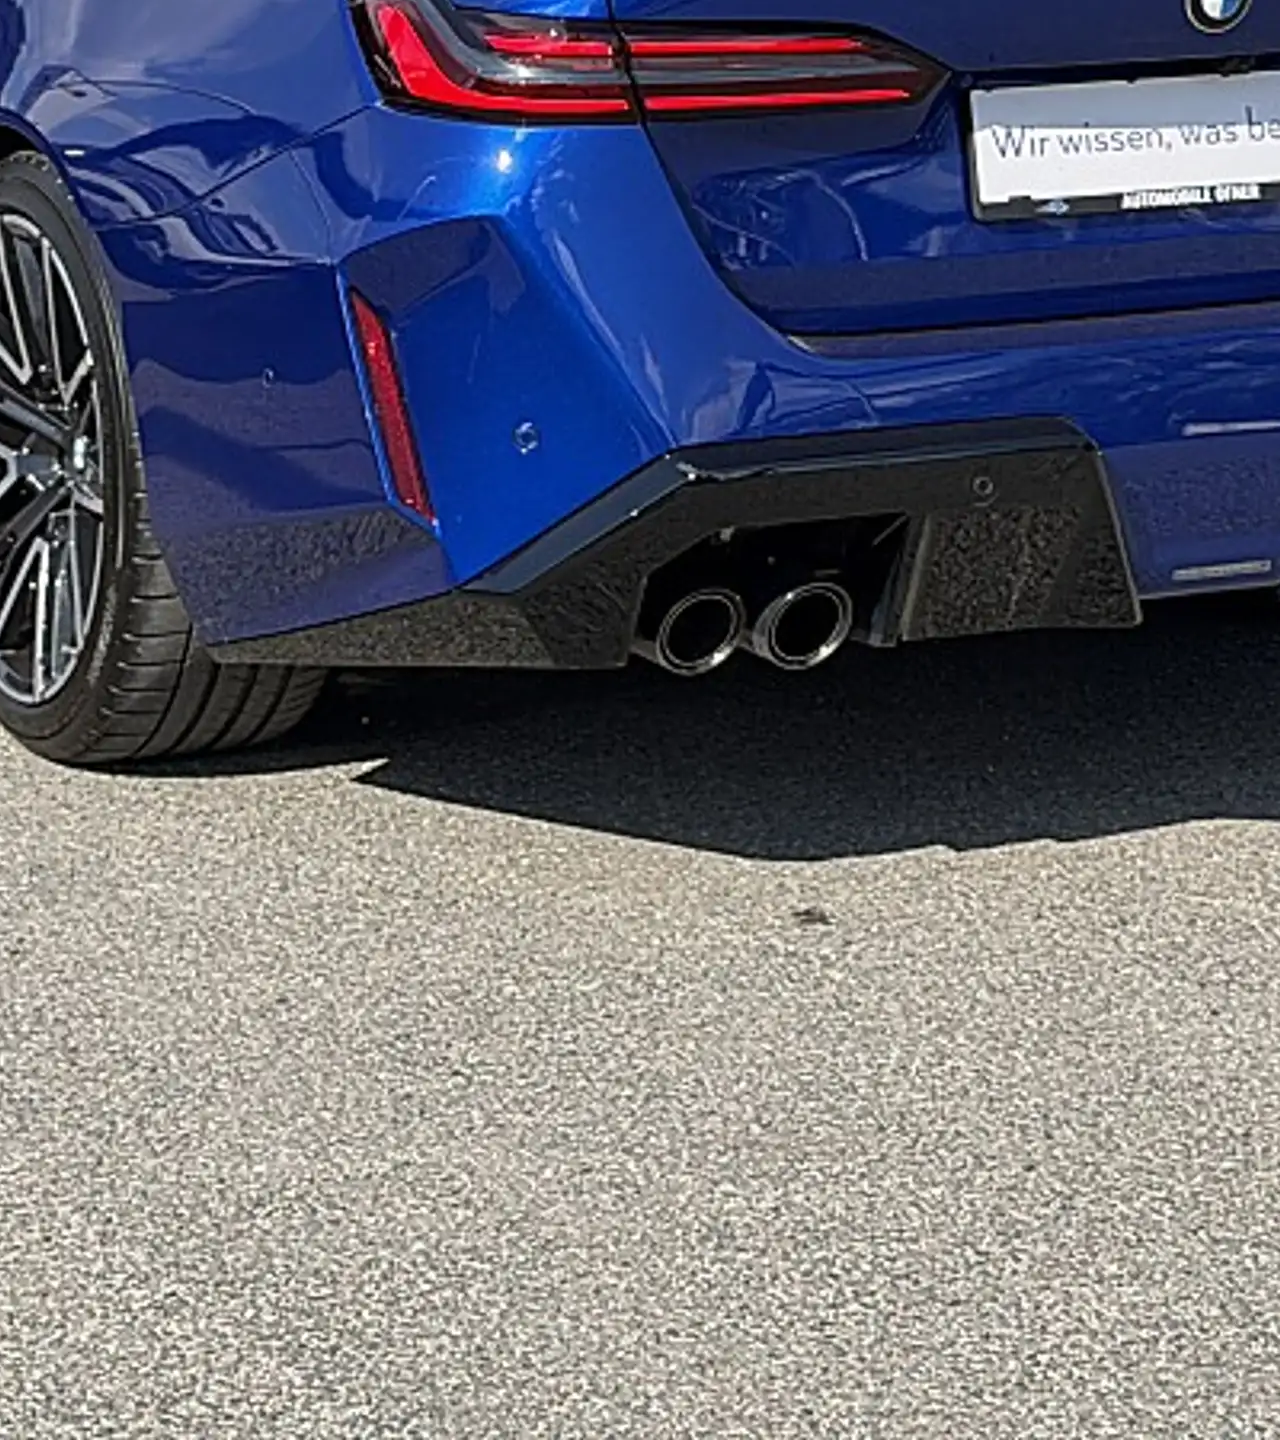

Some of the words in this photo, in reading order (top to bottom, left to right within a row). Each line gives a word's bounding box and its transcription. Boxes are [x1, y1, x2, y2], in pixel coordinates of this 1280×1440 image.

[991, 124, 1050, 159] Wir
[1058, 121, 1173, 156] wissen,
[1178, 118, 1239, 146] was
